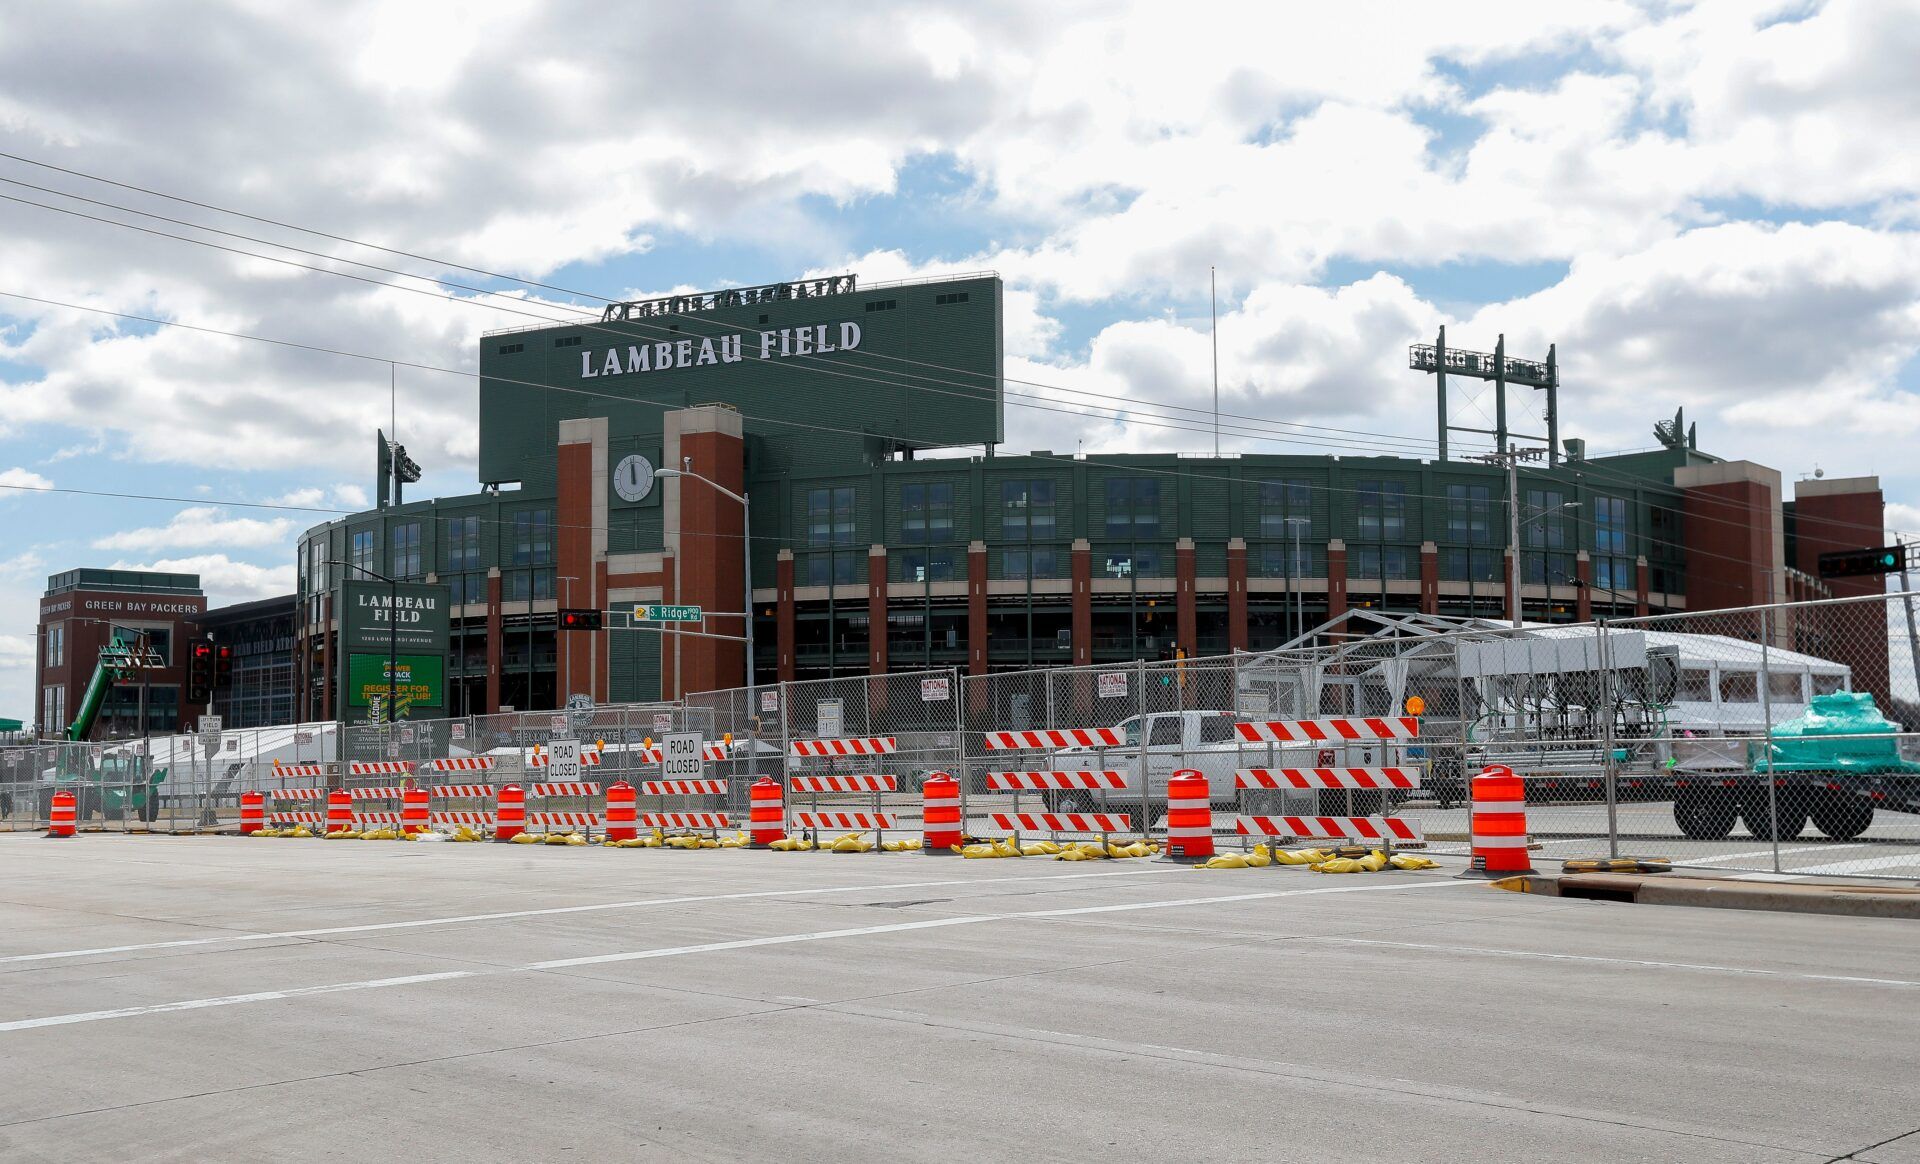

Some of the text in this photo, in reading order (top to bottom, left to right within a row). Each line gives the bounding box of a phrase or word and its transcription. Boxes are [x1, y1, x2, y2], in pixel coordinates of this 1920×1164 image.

[581, 321, 861, 378] LAMBEAU FIELD
[85, 600, 198, 614] GREEN BAY PACKERS
[359, 594, 435, 609] LAMBEAU
[650, 607, 688, 620] S. Ridge
[922, 680, 947, 689] NATIONAL
[1099, 674, 1126, 687] NATIONAL
[594, 732, 620, 741] GATE
[554, 746, 574, 758] ROAD
[670, 740, 695, 755] ROAD
[550, 763, 578, 777] CLOSED
[666, 758, 700, 774] CLOSED
[1406, 789, 1431, 798] LAMAR
